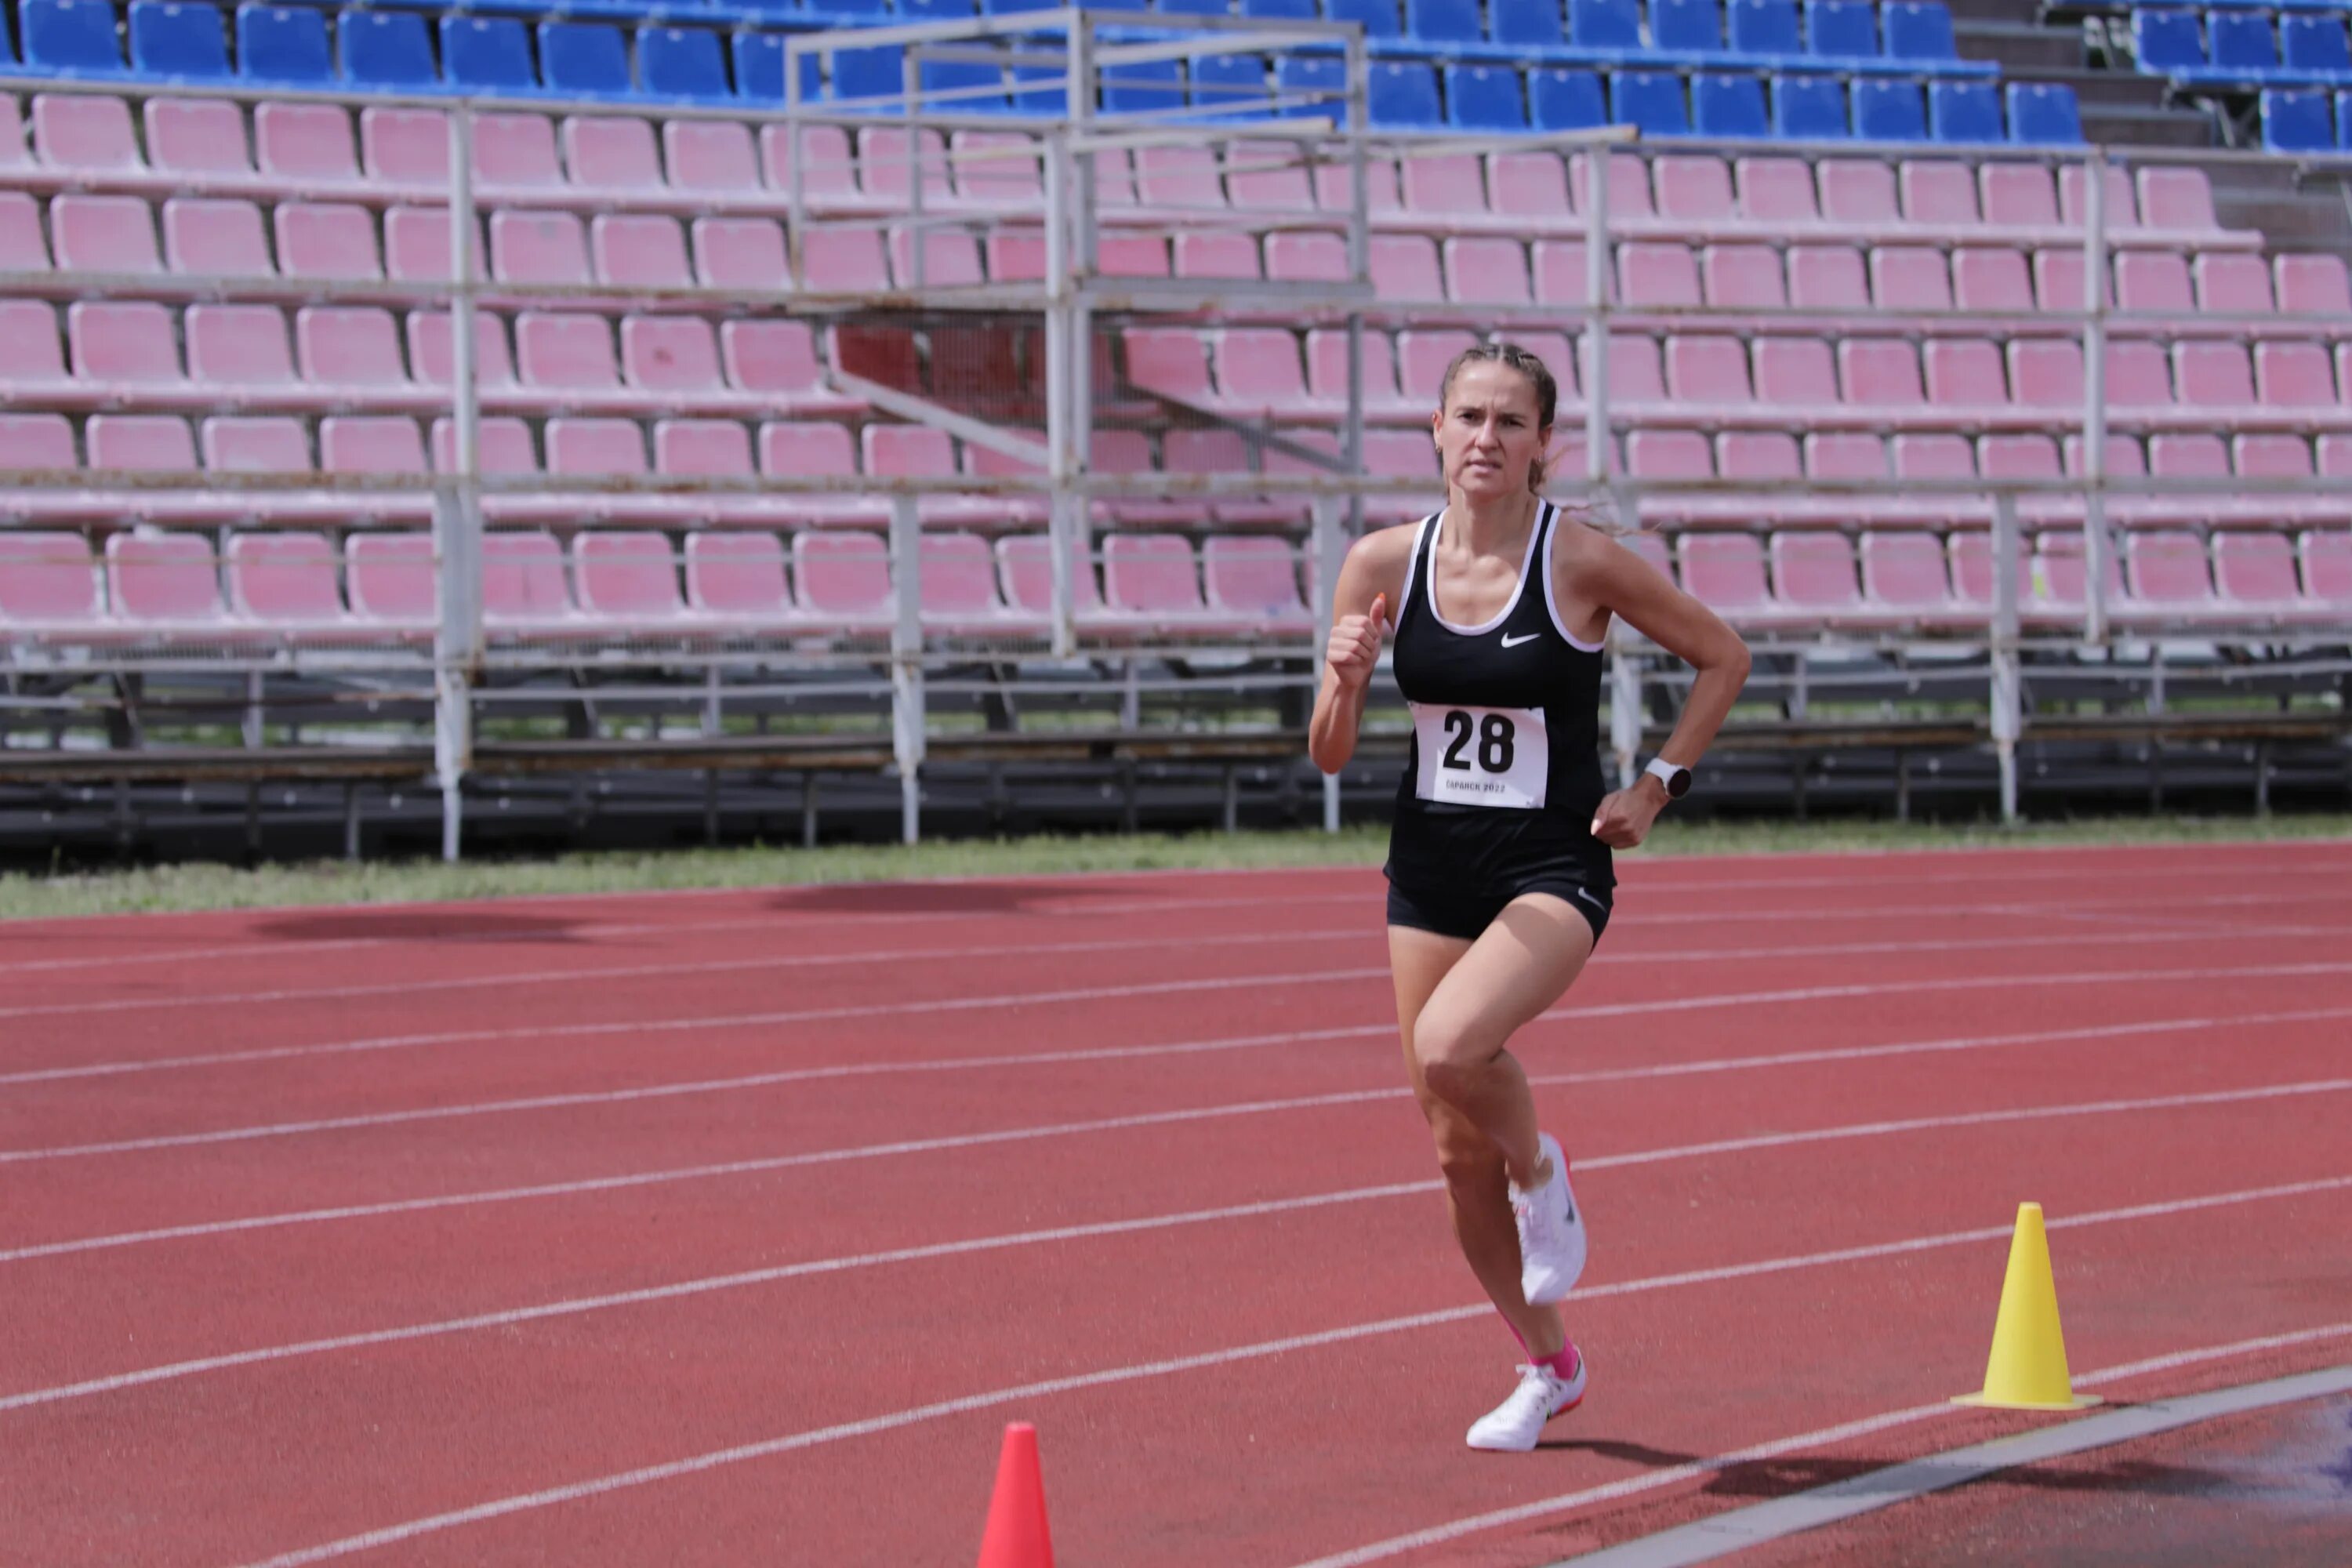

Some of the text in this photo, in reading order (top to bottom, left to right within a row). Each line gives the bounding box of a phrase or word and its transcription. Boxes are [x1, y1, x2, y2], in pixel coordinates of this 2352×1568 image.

[1443, 710, 1515, 773] 28
[1446, 779, 1505, 793] САРАНСК 2022
